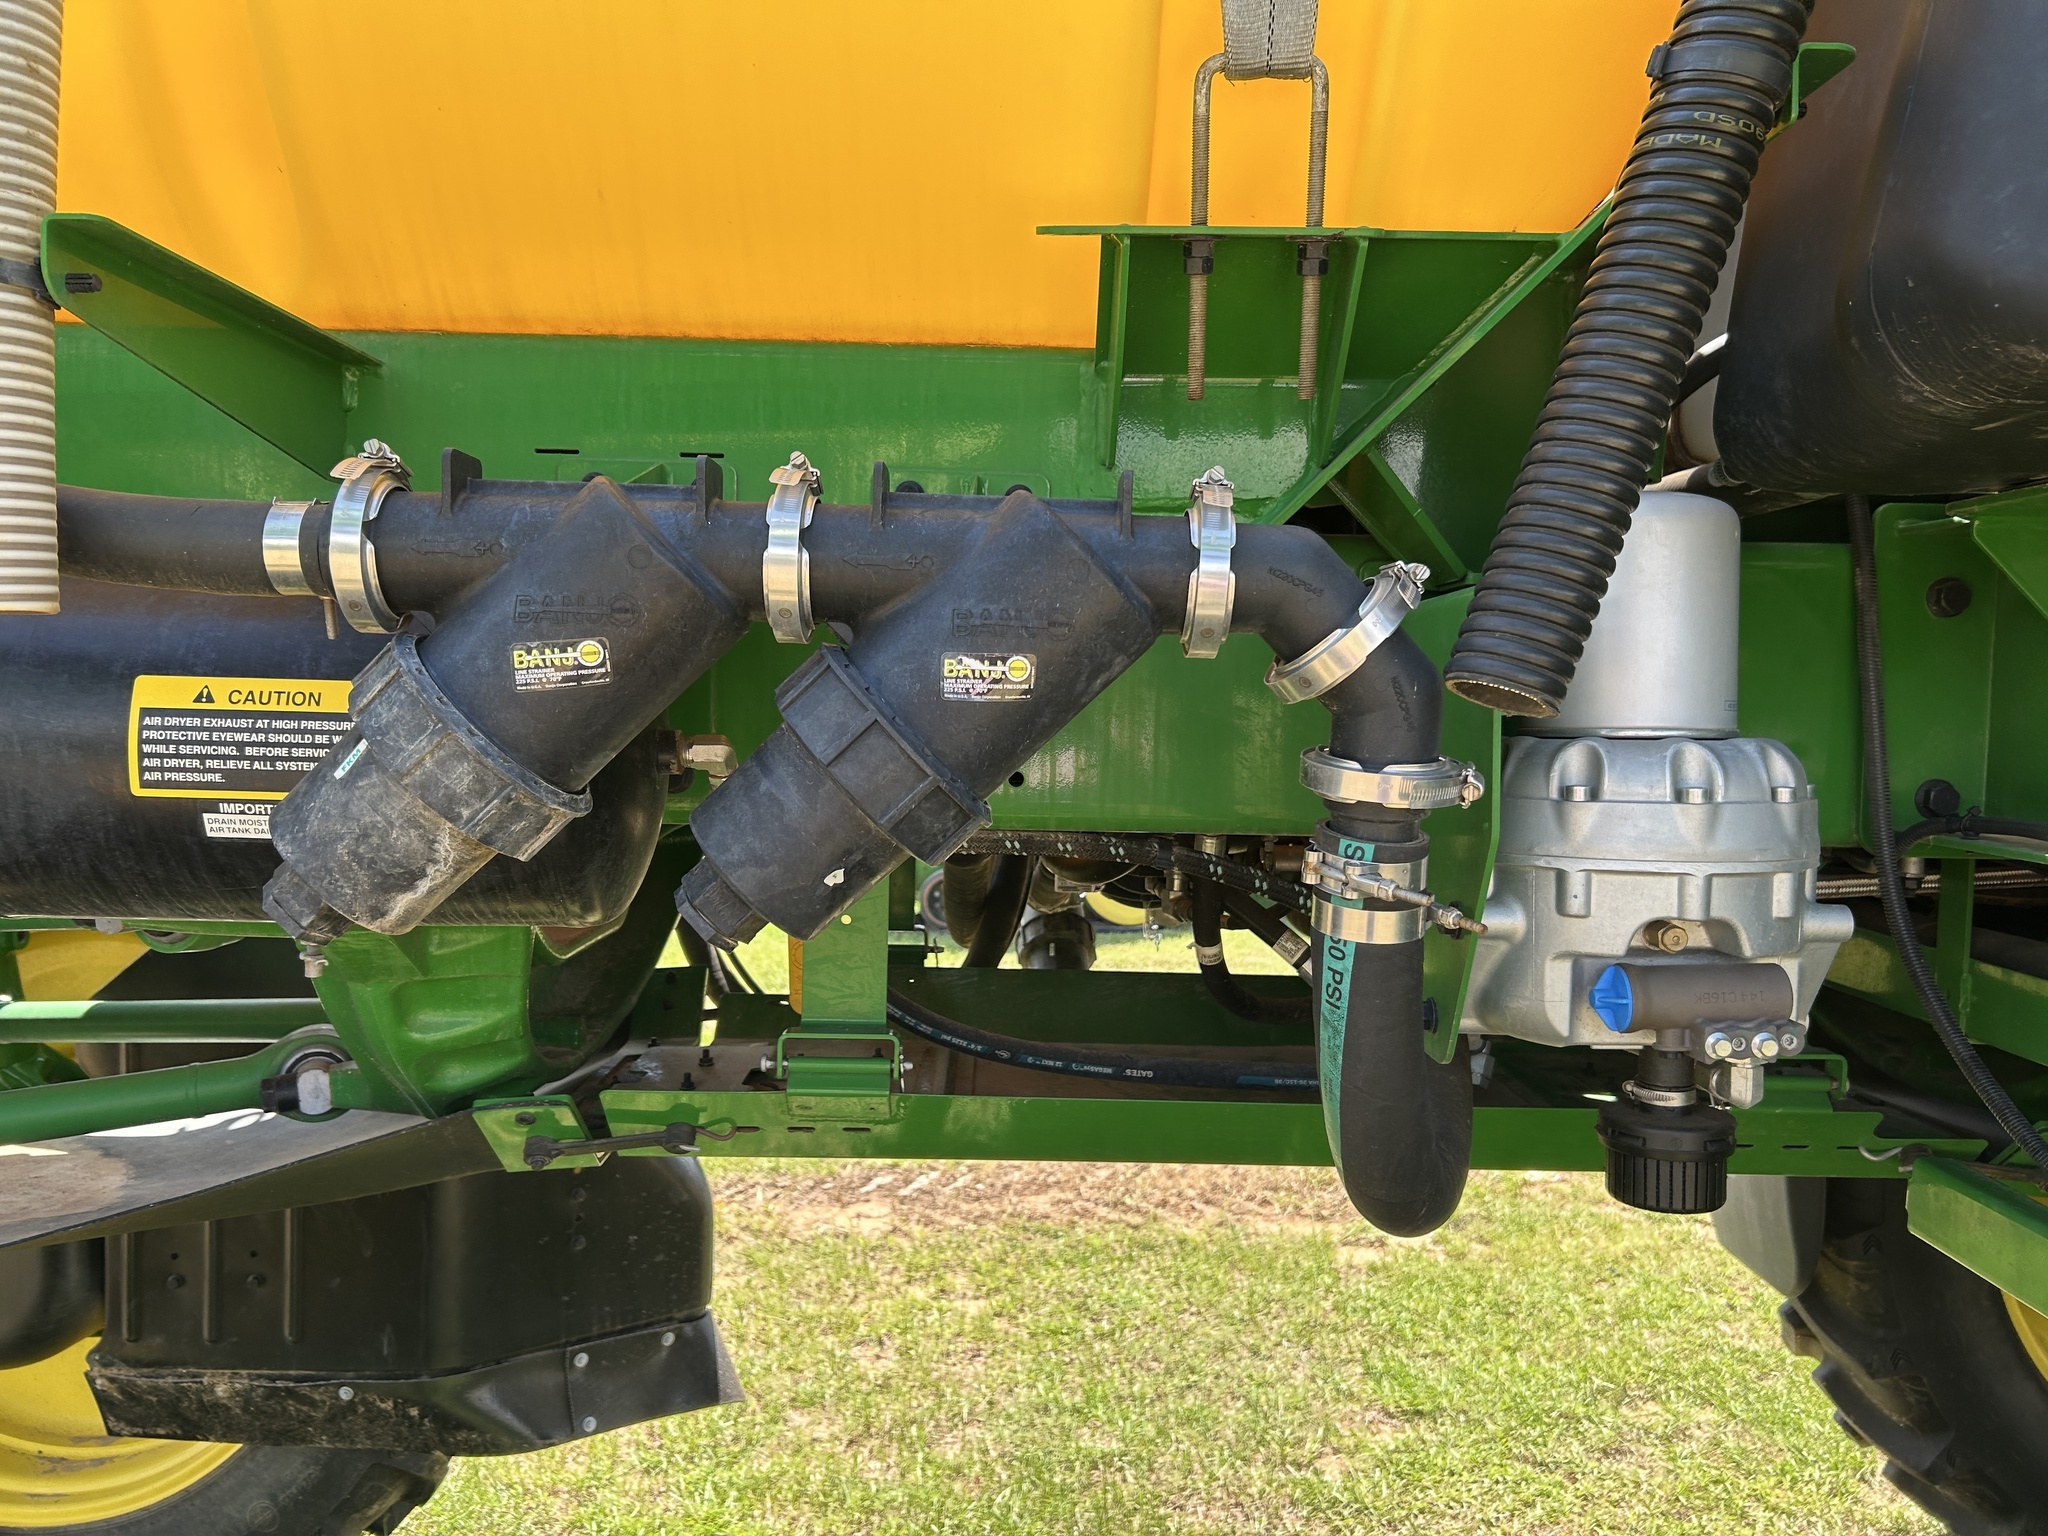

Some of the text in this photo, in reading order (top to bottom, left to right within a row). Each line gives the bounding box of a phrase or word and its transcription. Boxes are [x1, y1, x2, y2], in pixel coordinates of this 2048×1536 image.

[513, 640, 604, 669] BANJO
[545, 670, 577, 678] OPERATING
[943, 655, 1031, 682] BANJO
[228, 689, 322, 707] CAUTION
[143, 716, 162, 726] AIR
[164, 717, 201, 727] DRYER
[203, 718, 254, 729] EXHAUST
[255, 719, 270, 729] AT
[272, 719, 298, 730] HIGH
[142, 730, 210, 741] PROTECTIVE
[212, 731, 266, 743] EYEWEAR
[267, 733, 313, 744] SHOULD
[315, 735, 330, 744] BE
[142, 744, 177, 754] WHILE
[178, 745, 240, 756] SERVICING.
[245, 746, 289, 757] BEFORE
[142, 758, 161, 767] AIR
[163, 758, 203, 770] DRYER,
[205, 759, 251, 770] RELIEVE
[253, 760, 274, 770] ALL
[341, 748, 361, 772] FKM
[143, 771, 226, 783] AIR PRESSURE.
[219, 802, 277, 815] IMPORT
[207, 818, 268, 827] DRAIN MOIST
[1324, 964, 1345, 1011] PSI
[1125, 1068, 1154, 1078] GATES
